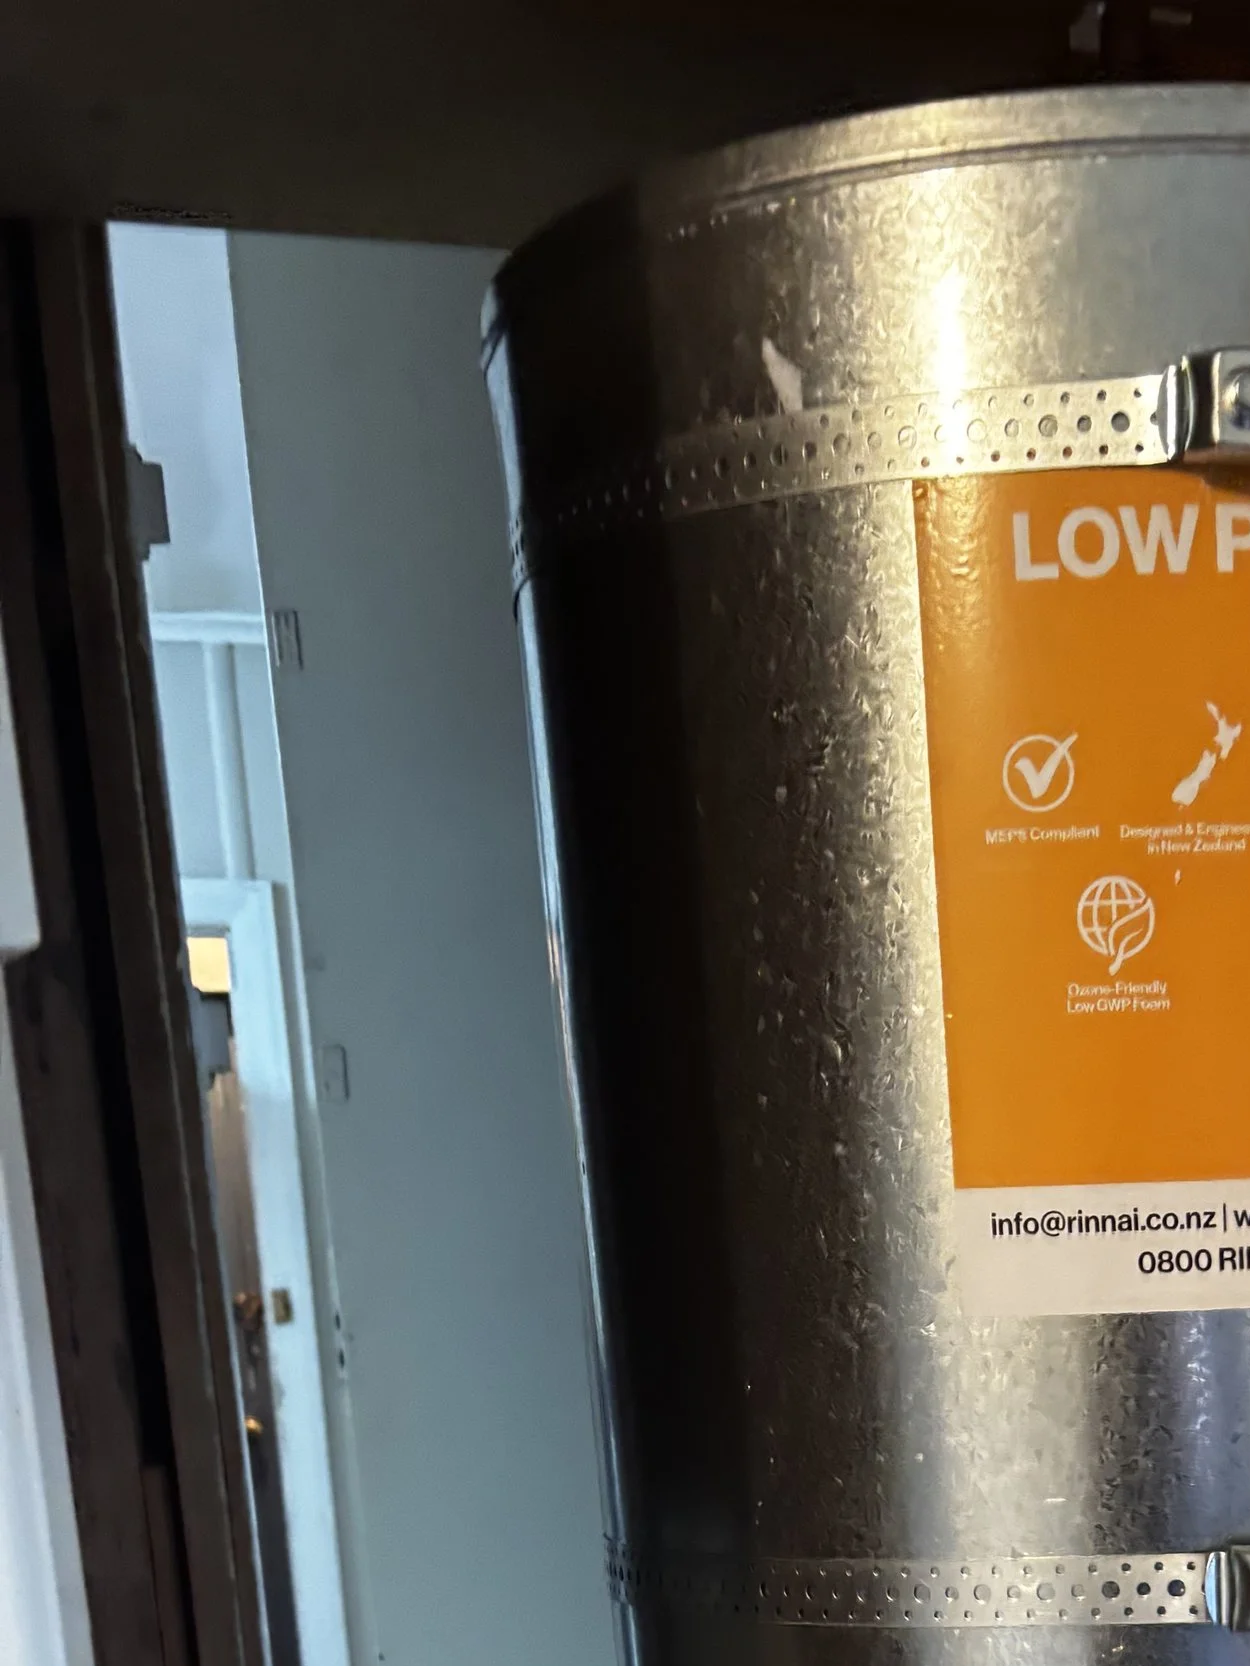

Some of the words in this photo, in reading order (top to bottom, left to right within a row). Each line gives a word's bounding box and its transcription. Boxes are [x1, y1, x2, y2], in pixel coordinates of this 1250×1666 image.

[1013, 504, 1198, 581] LOW
[1030, 824, 1100, 842] Compliant
[1120, 823, 1183, 840] Designed
[1161, 840, 1191, 853] New
[1193, 838, 1246, 852] Zealand
[1067, 980, 1168, 999] Ozone-Friendly
[1067, 999, 1095, 1014] Low
[1096, 999, 1131, 1012] GWP
[1132, 997, 1171, 1012] Foam
[990, 1206, 1218, 1239] info@rinnai.co.nz
[1137, 1248, 1213, 1275] 0800
